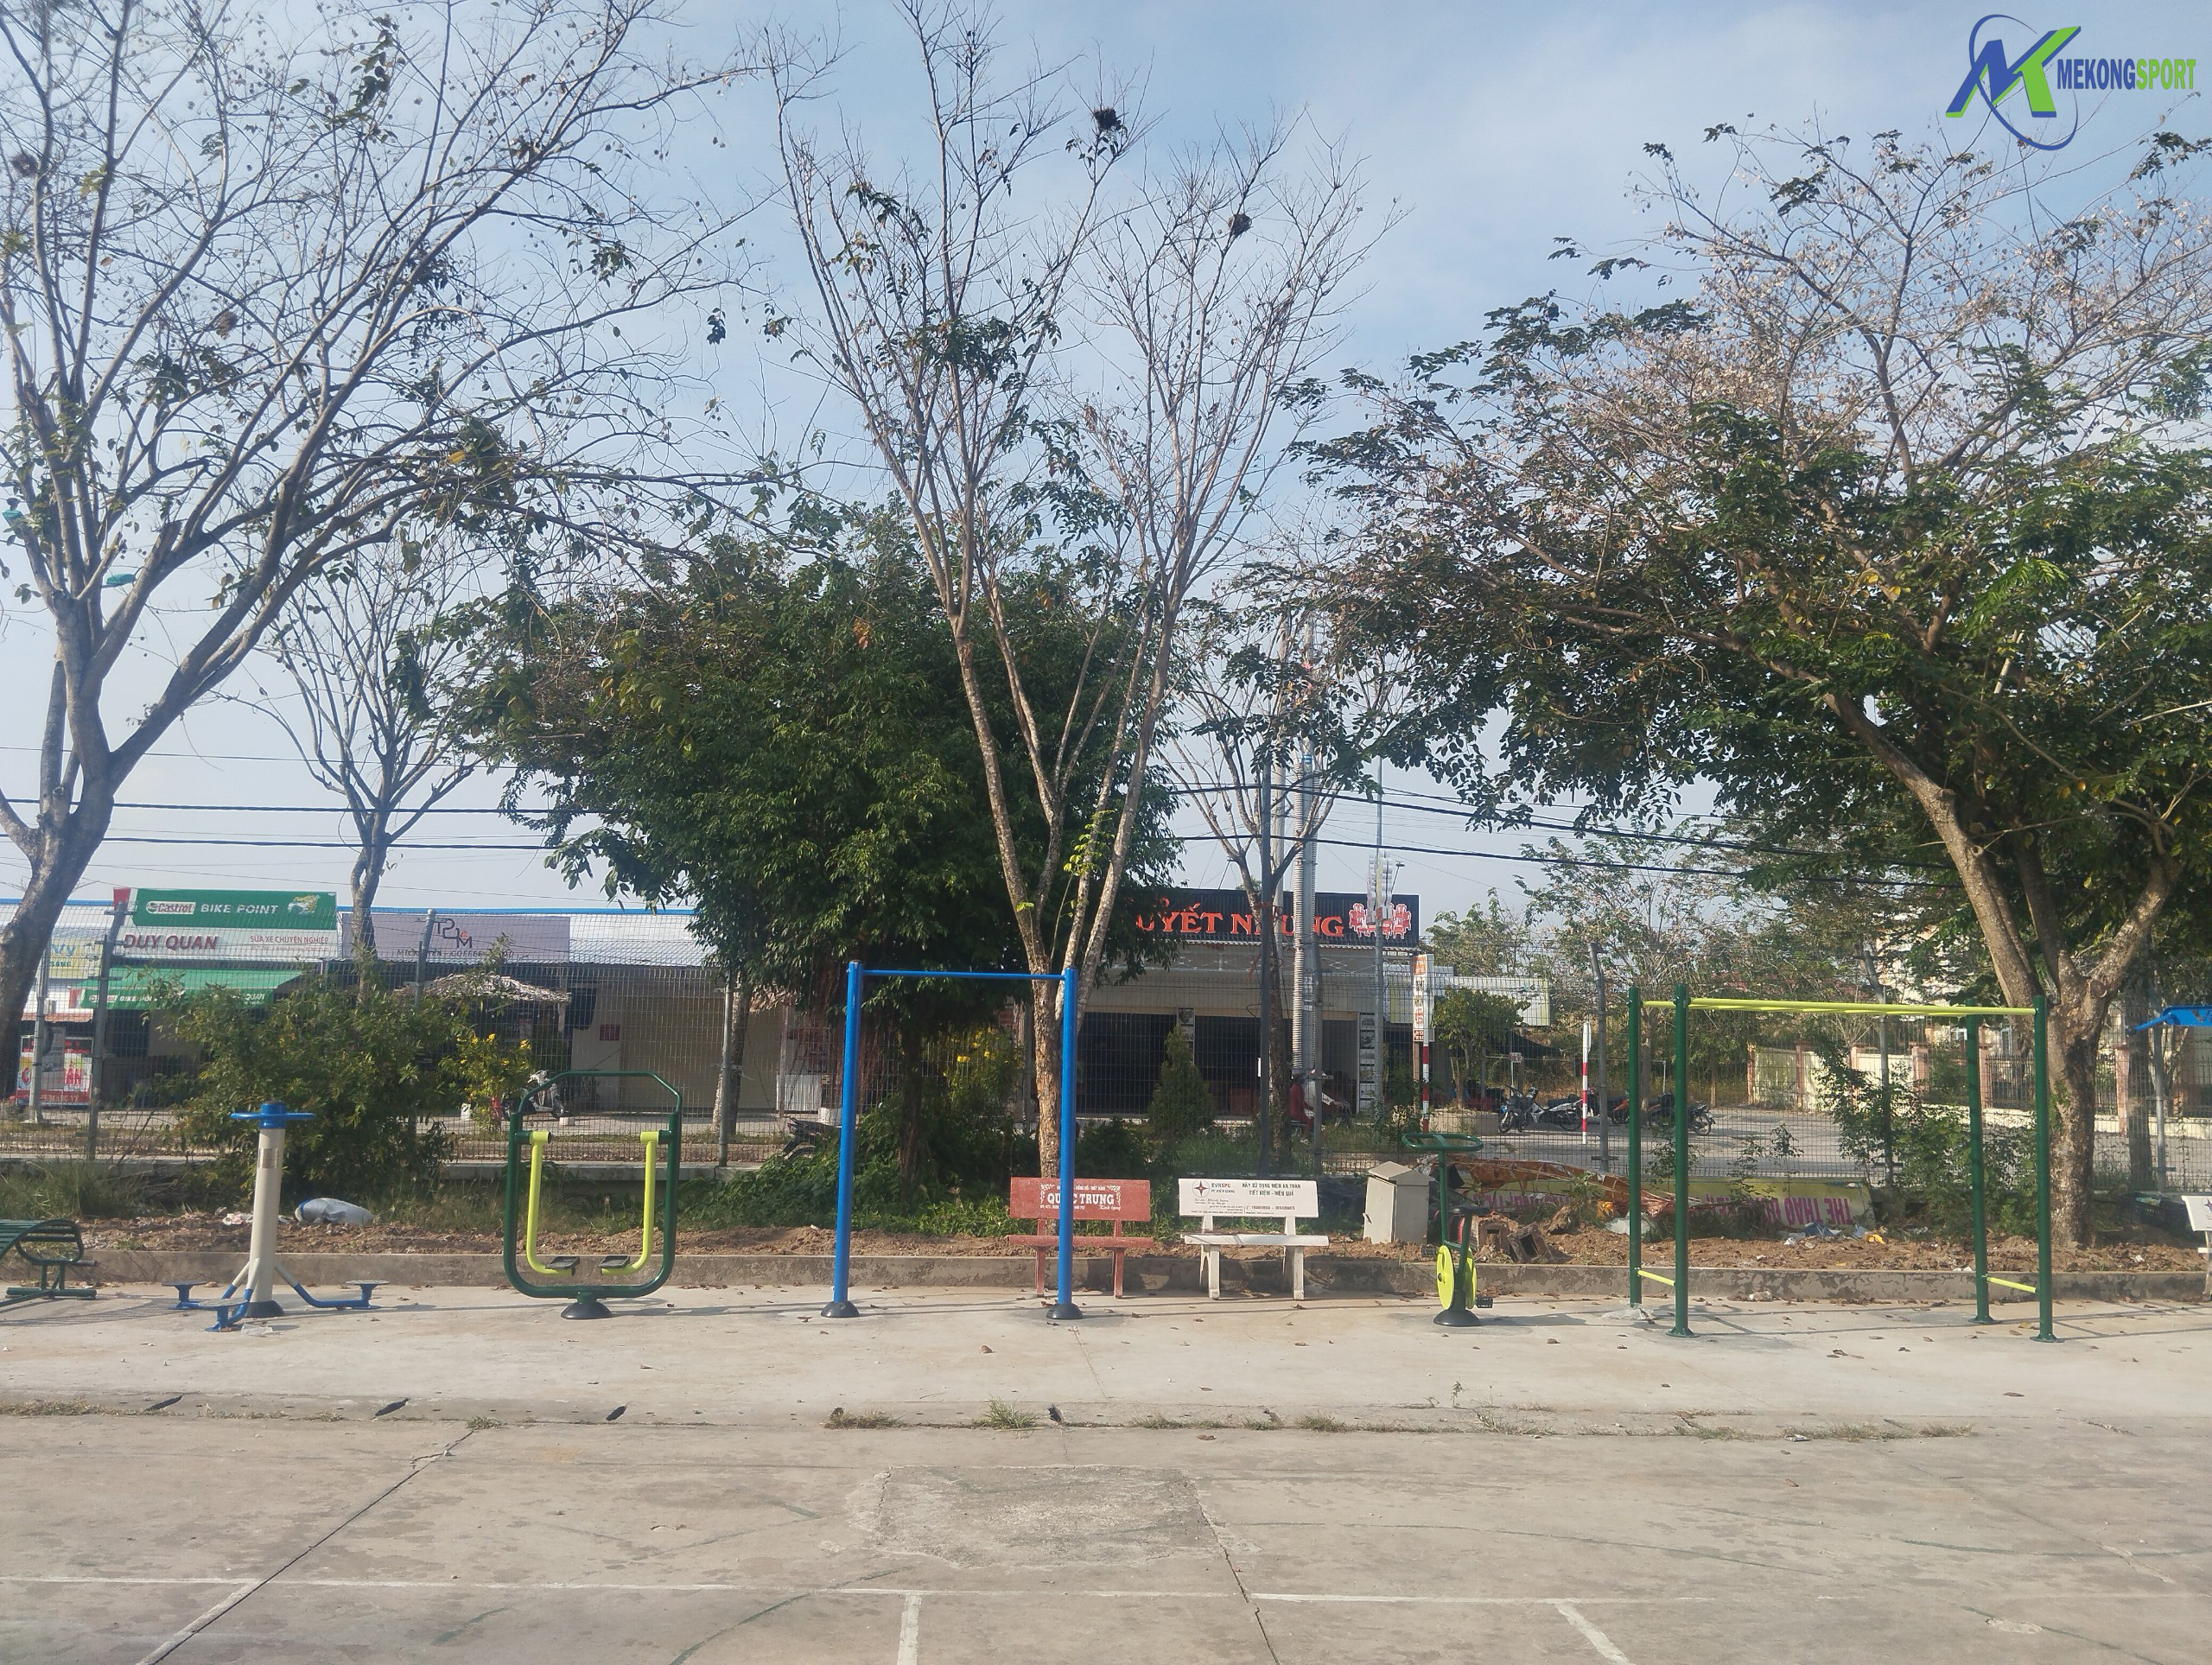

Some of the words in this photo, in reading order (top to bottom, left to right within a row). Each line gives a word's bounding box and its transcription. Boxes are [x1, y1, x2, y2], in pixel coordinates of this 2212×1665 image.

[157, 902, 194, 913] Castrol
[200, 904, 232, 913] BIKE
[237, 905, 278, 914] POINT
[1135, 902, 1224, 934] UYẾT
[1230, 913, 1344, 937] NUG
[124, 935, 162, 949] DUY
[165, 935, 219, 950] QUAN
[1047, 1192, 1078, 1204] QUC
[1079, 1193, 1115, 1204] TRUNG
